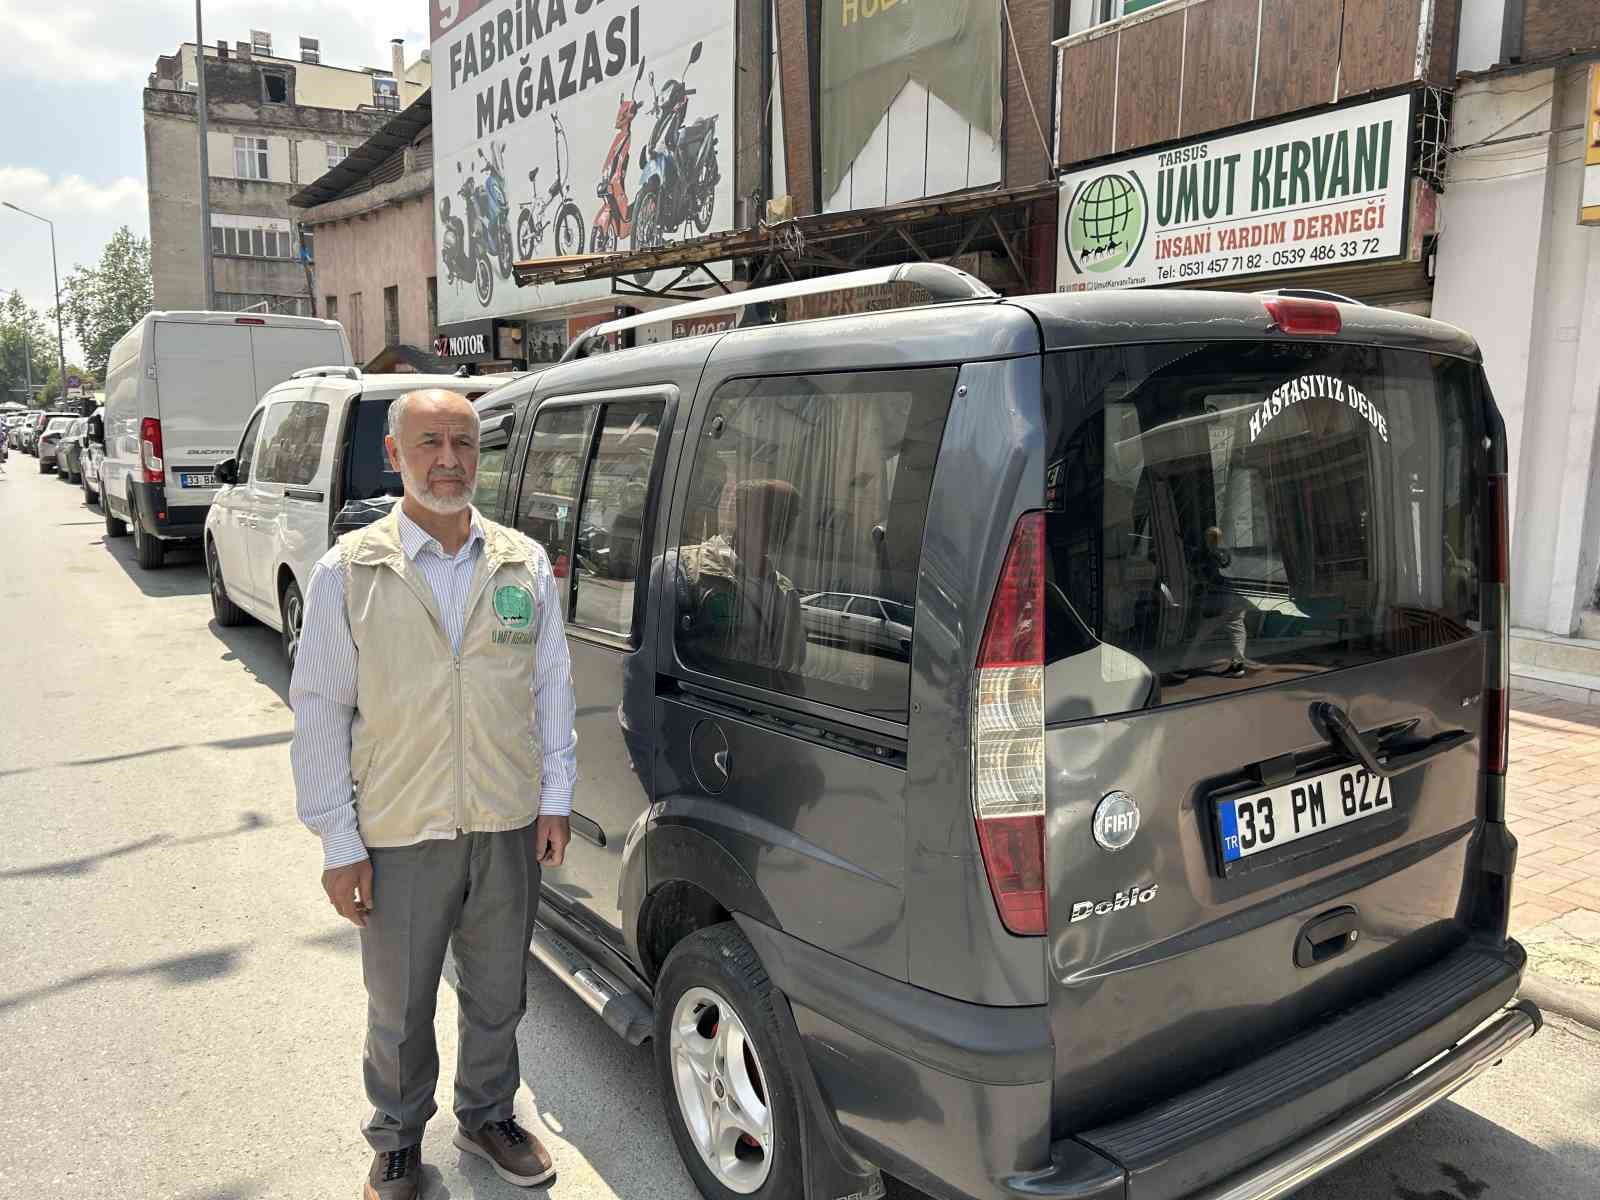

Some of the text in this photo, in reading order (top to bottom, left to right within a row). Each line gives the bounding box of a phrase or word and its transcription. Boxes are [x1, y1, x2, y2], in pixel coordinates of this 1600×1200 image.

[449, 0, 567, 91] FABRİKA
[476, 5, 640, 139] MAĞAZASI
[1156, 119, 1393, 227] UMUT KERVANI
[1158, 144, 1208, 167] TARSUS
[1155, 198, 1386, 260] İNSANİ YARDIM DERNEĞİ
[1157, 265, 1176, 280] Tel:
[1179, 261, 1204, 277] 0531
[1207, 257, 1229, 273] 457
[1232, 256, 1243, 271] 71
[1246, 253, 1262, 269] 82
[1272, 247, 1306, 266] 0539
[1310, 244, 1336, 261] 486
[1340, 240, 1358, 258] 33
[1362, 237, 1380, 255] 72
[449, 334, 485, 356] MOTOR
[1248, 374, 1388, 443] HASTASIYIZ DEDE
[1104, 811, 1134, 834] FIAT
[1238, 769, 1389, 850] 33 PM 822
[1224, 835, 1239, 850] TR
